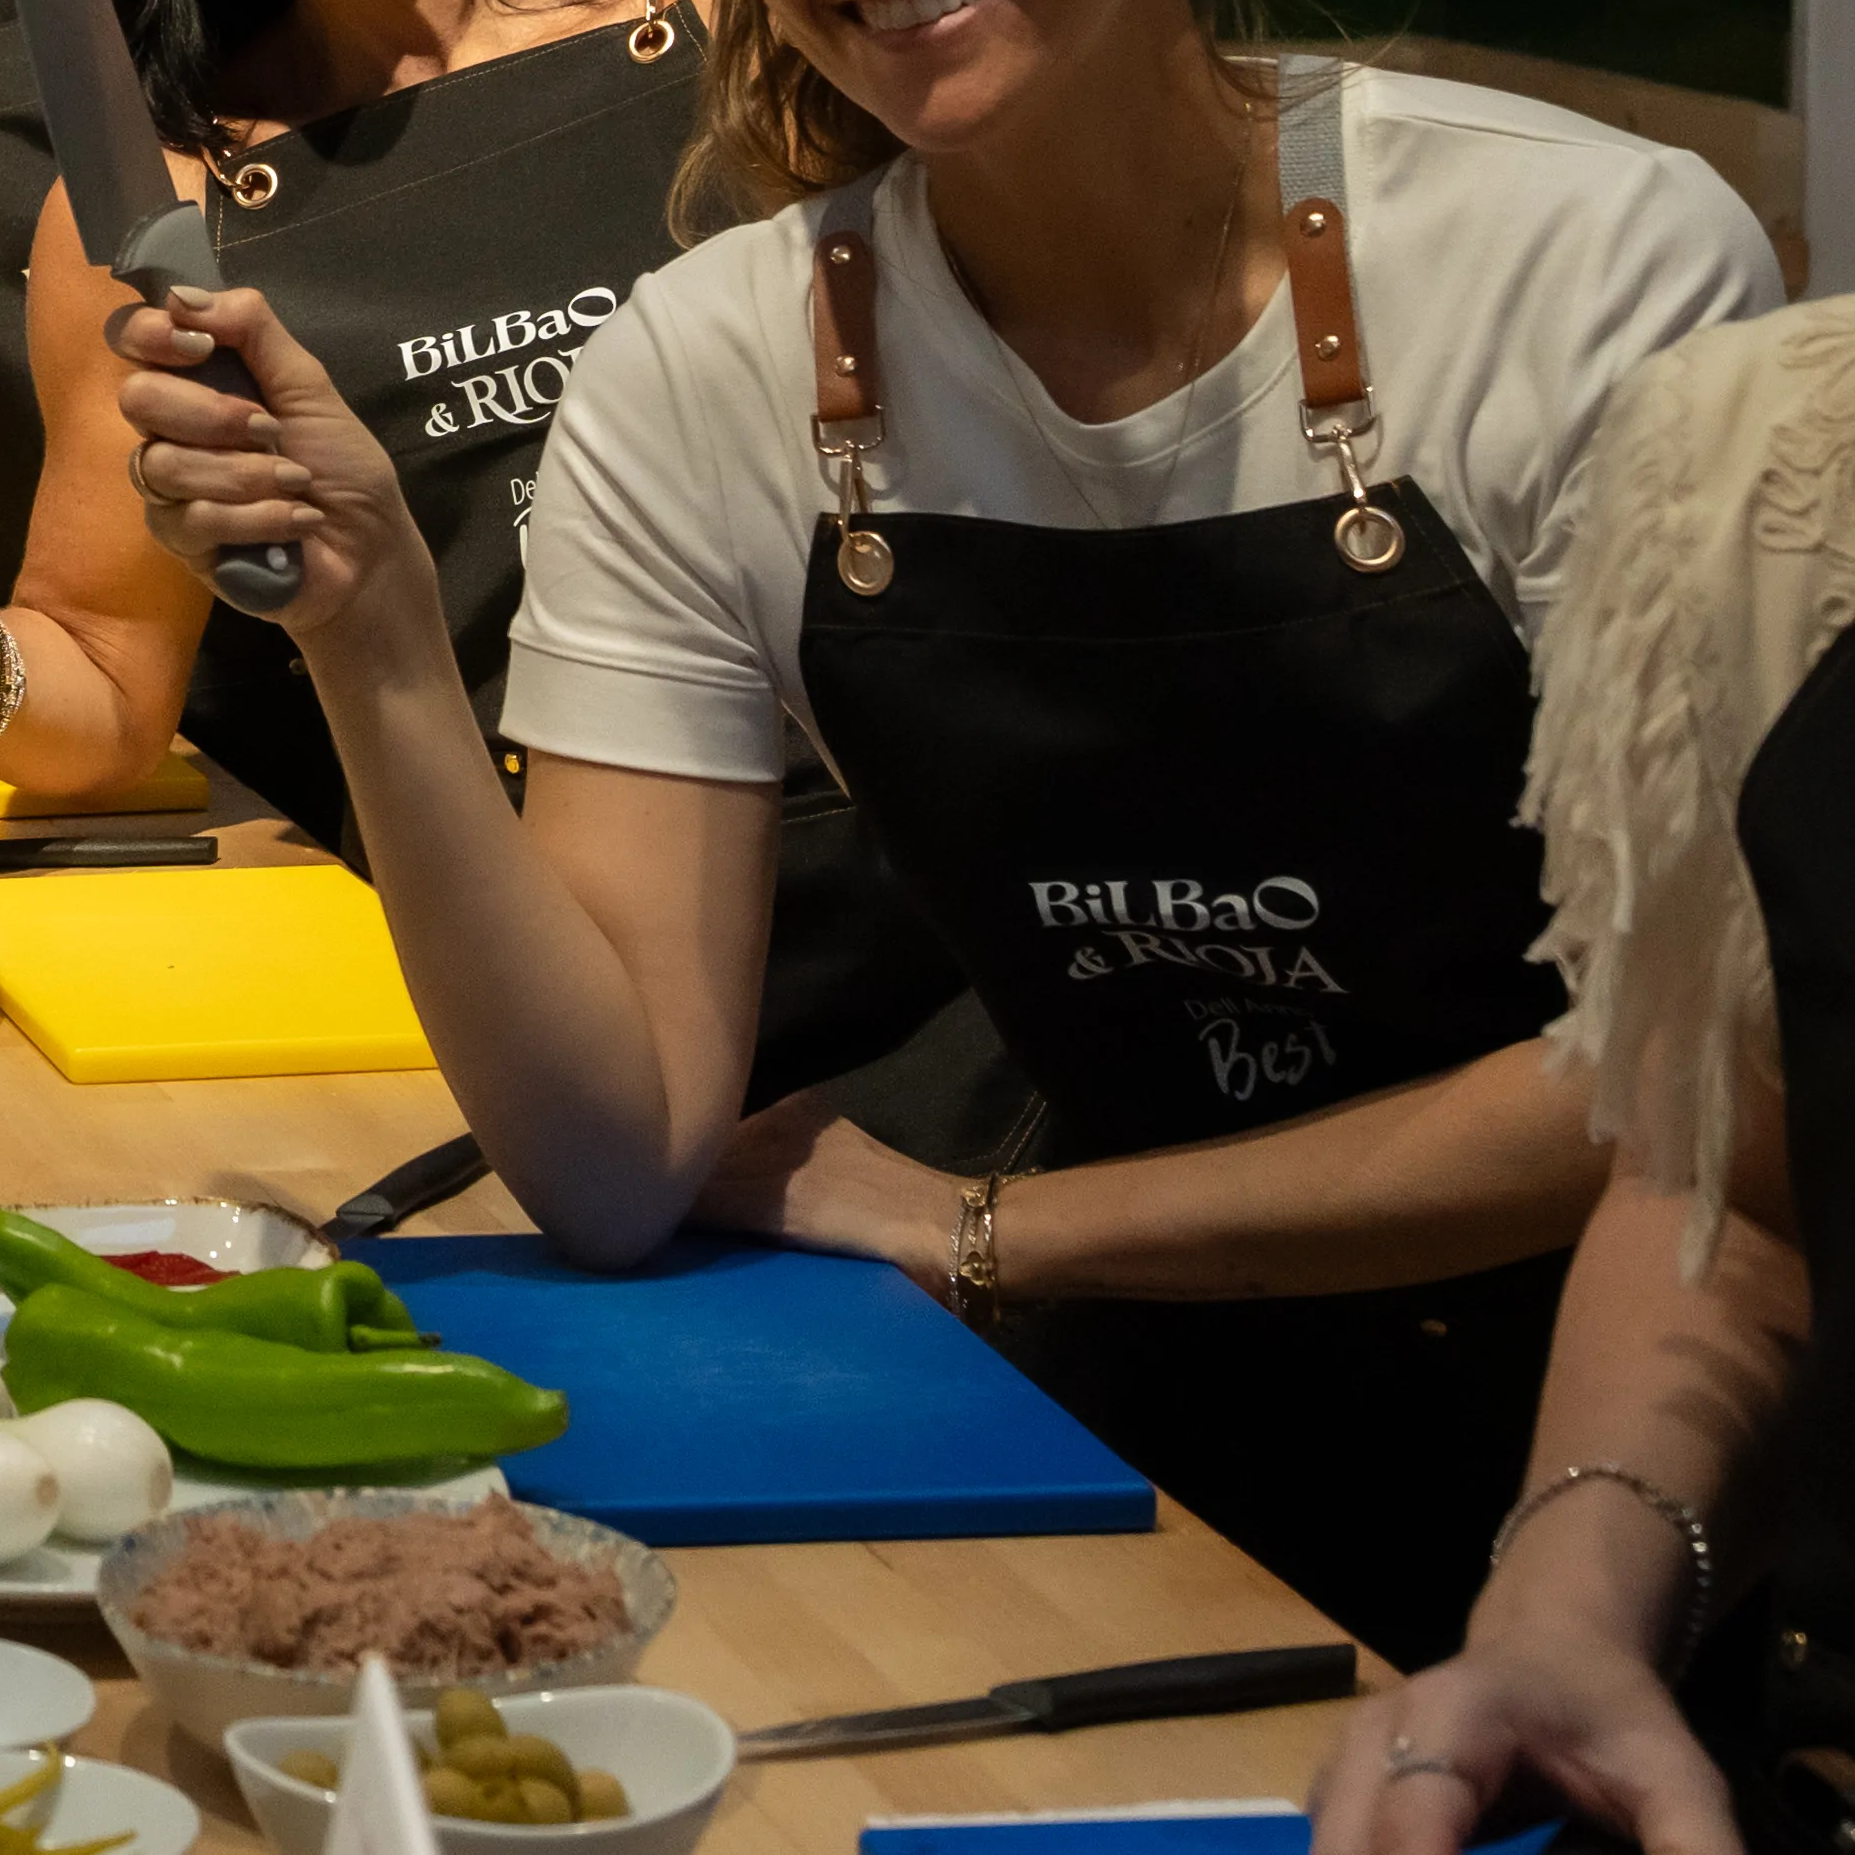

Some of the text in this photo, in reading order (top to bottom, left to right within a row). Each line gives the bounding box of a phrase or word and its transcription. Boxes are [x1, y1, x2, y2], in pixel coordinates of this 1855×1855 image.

[424, 346, 585, 438] & RIO
[1067, 930, 1351, 994] & RIOJA
[1198, 1018, 1338, 1102] Best
